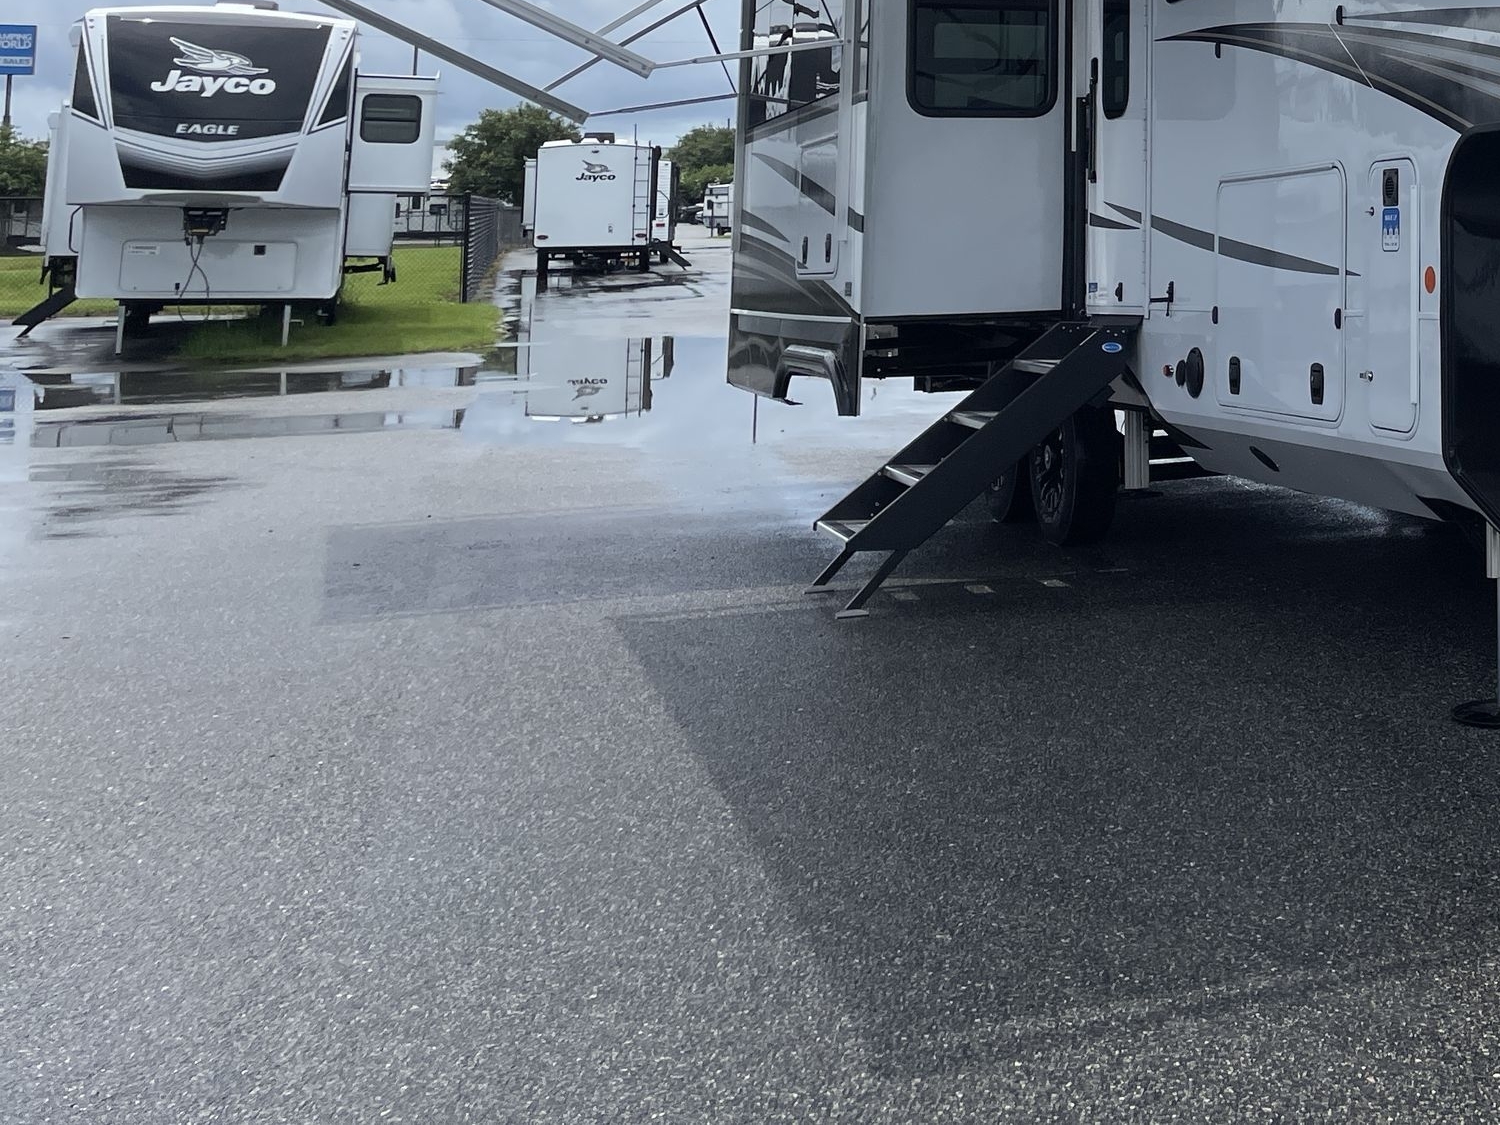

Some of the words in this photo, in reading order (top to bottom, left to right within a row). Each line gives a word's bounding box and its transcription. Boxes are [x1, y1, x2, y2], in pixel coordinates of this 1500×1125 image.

[150, 69, 277, 98] Jayco
[175, 123, 240, 136] EAGLE
[575, 172, 617, 182] Jayco
